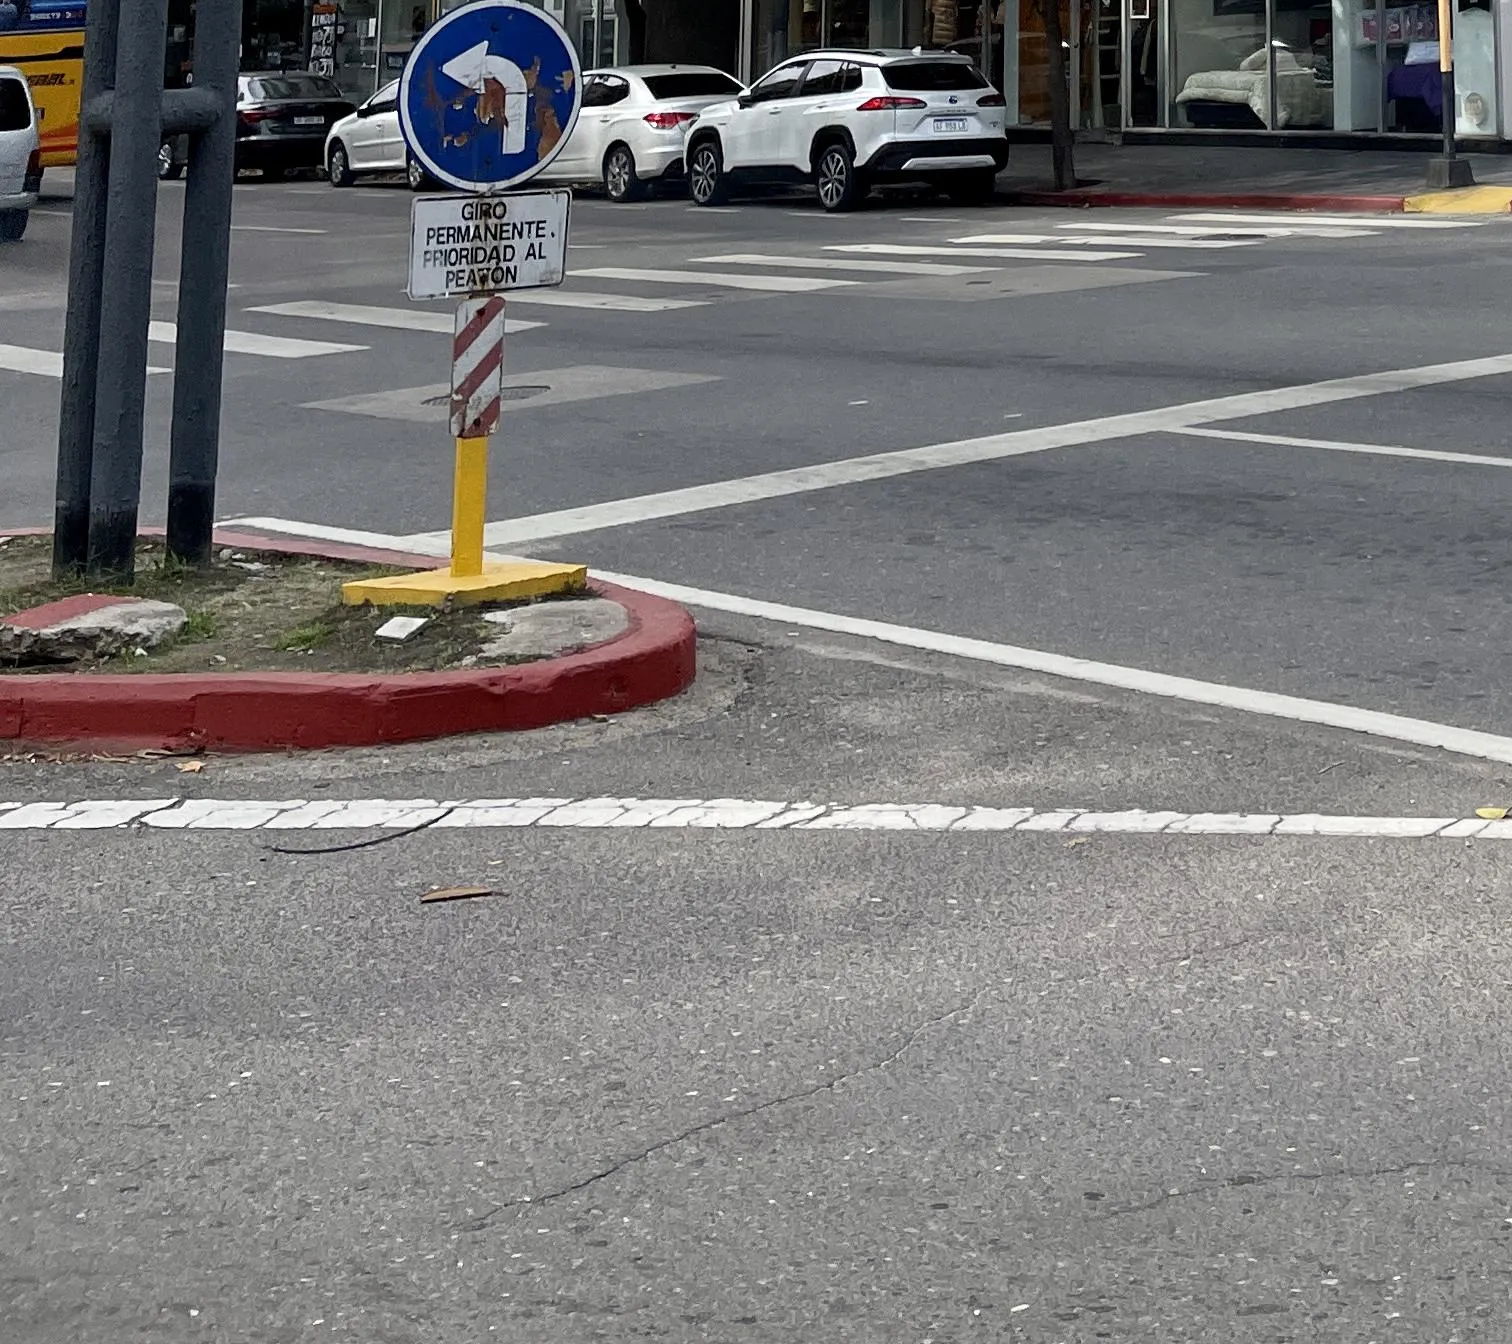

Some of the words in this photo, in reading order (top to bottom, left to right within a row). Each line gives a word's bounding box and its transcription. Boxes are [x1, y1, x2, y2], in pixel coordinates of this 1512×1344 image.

[461, 201, 507, 221] GIRO
[423, 245, 516, 268] PRIORIDAD
[525, 242, 547, 261] AL
